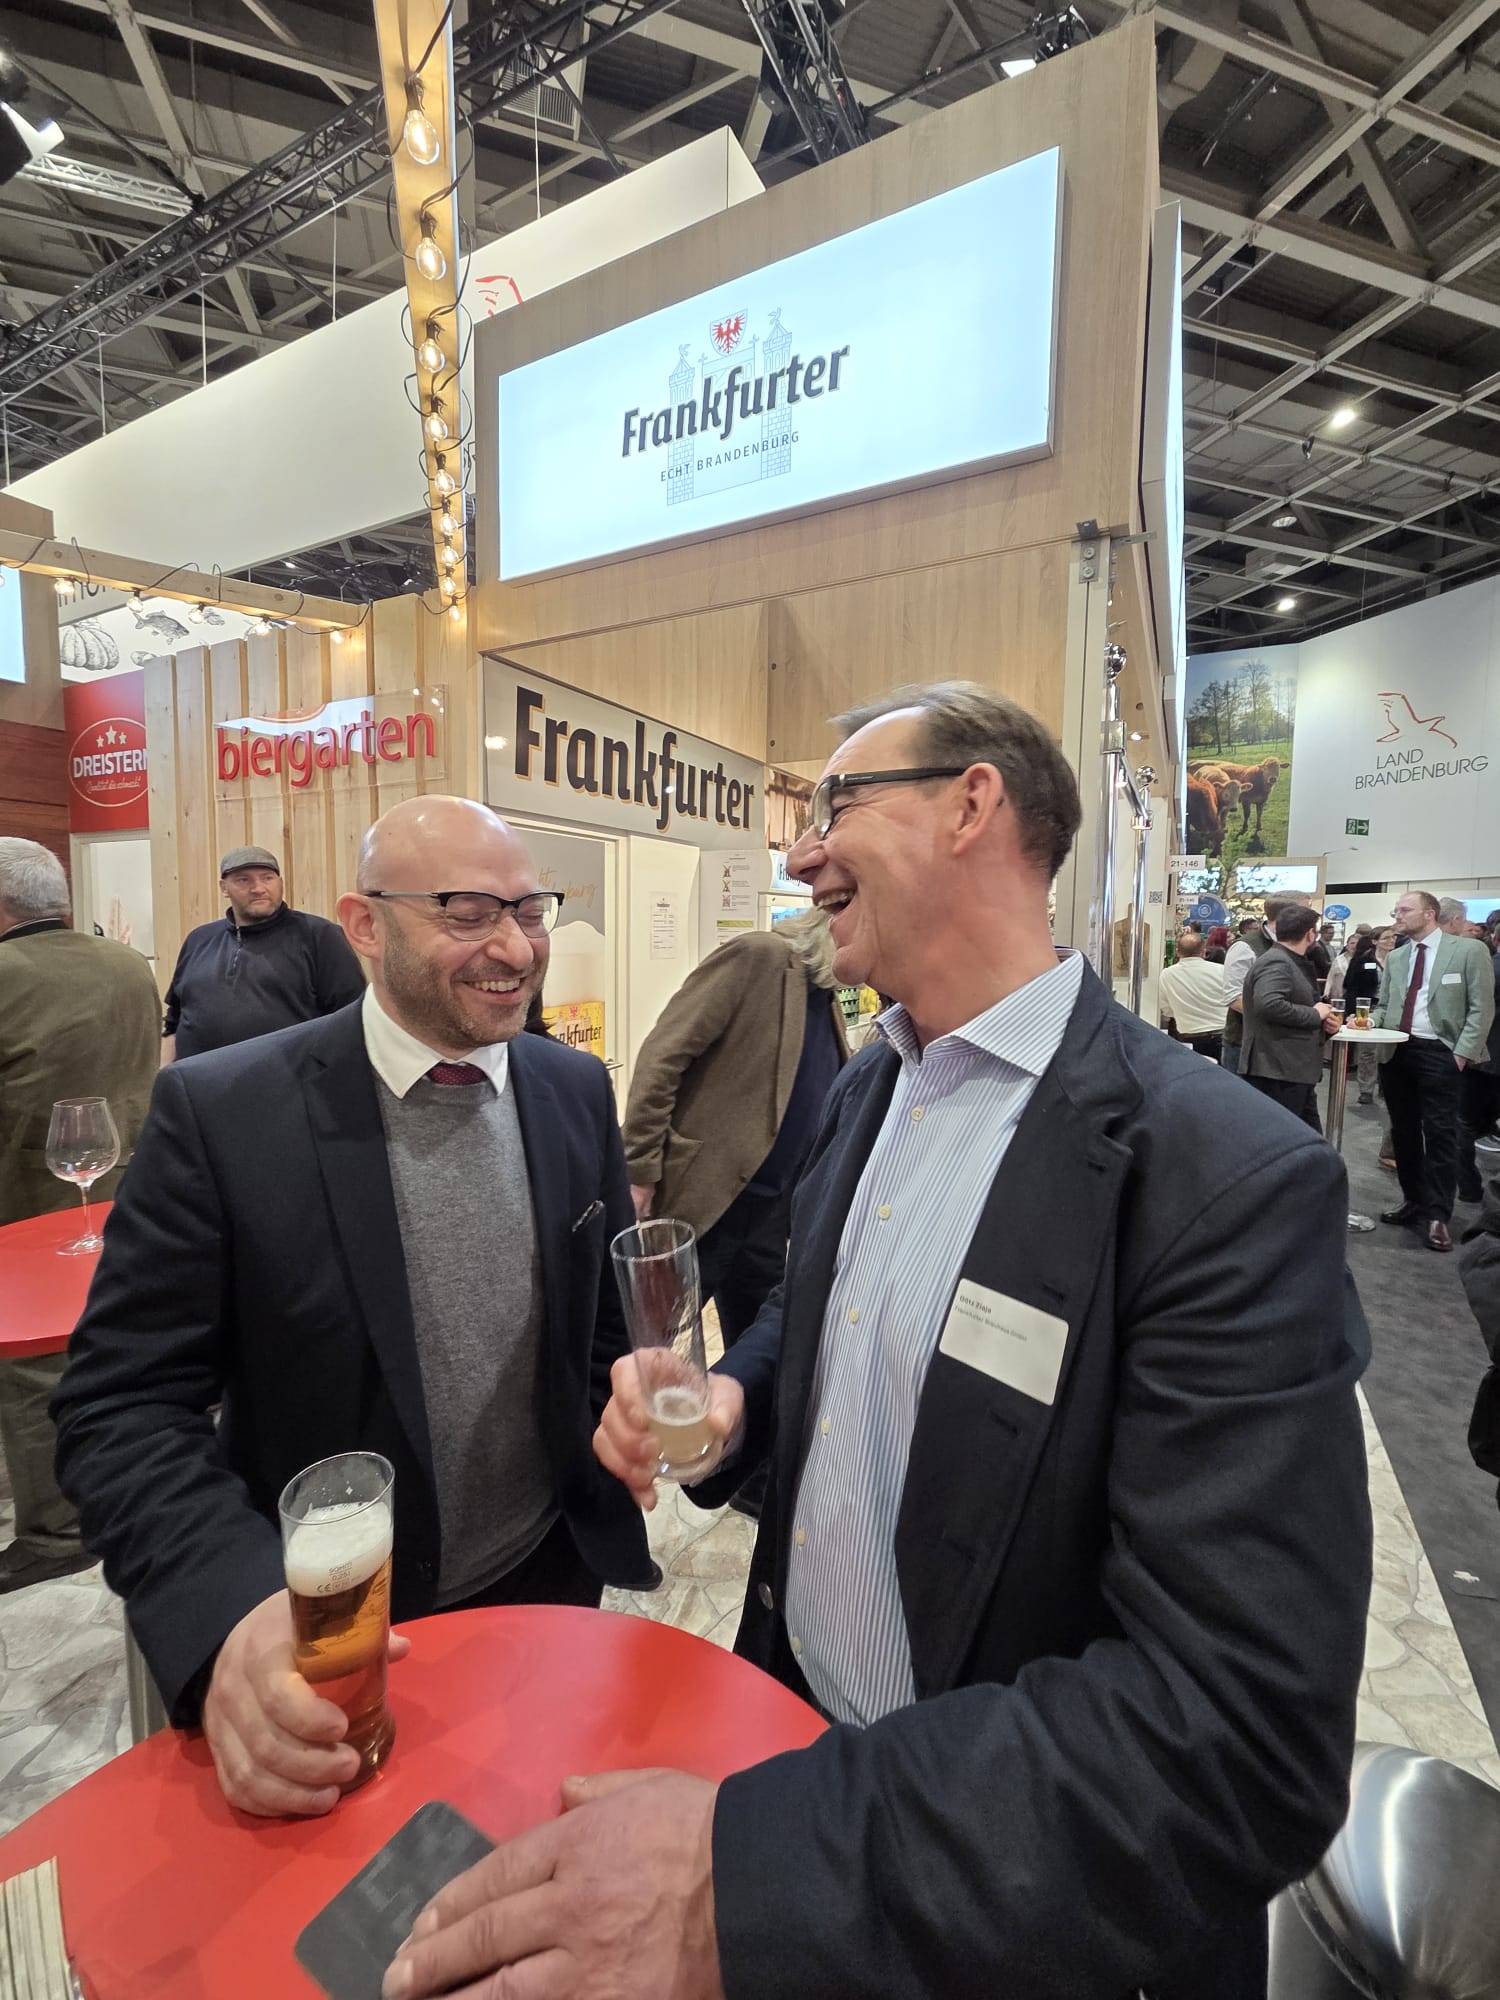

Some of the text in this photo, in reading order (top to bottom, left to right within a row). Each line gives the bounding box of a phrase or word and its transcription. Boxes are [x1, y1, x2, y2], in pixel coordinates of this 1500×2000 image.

[621, 344, 851, 458] Frankfurter
[660, 431, 800, 482] ECHT BRANDENBURG
[216, 710, 435, 788] biergarten
[514, 685, 755, 832] Frankfurter
[1355, 755, 1489, 790] BRANDENBURG
[1376, 748, 1424, 770] LAND
[557, 1024, 602, 1049] nkfurter
